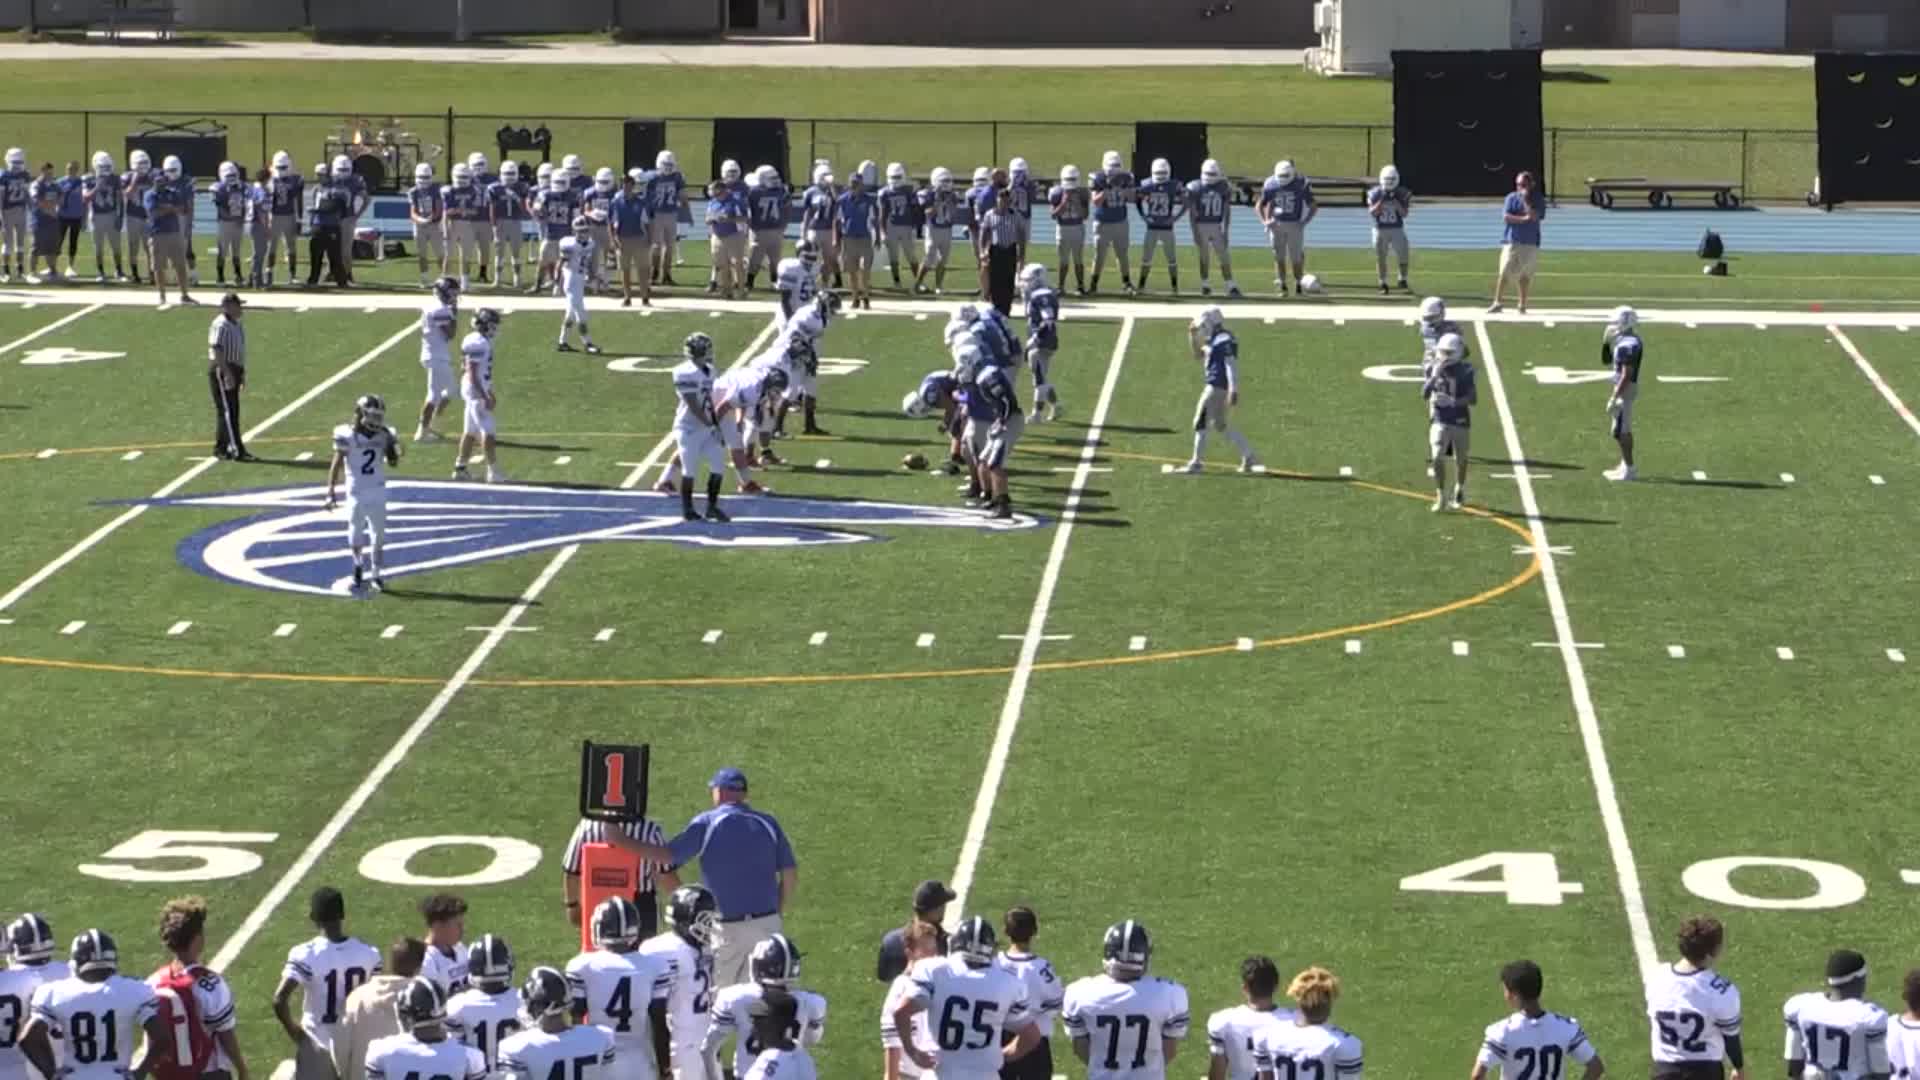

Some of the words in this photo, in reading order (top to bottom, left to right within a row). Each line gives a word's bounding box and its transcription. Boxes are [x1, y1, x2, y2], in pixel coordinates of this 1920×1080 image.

[361, 449, 376, 475] 2
[602, 753, 626, 806] 1
[605, 977, 632, 1032] 4
[938, 996, 999, 1052] 65
[71, 1010, 117, 1063] 81
[1096, 1015, 1149, 1070] 77
[1656, 1012, 1707, 1053] 52
[1804, 1024, 1851, 1071] 17
